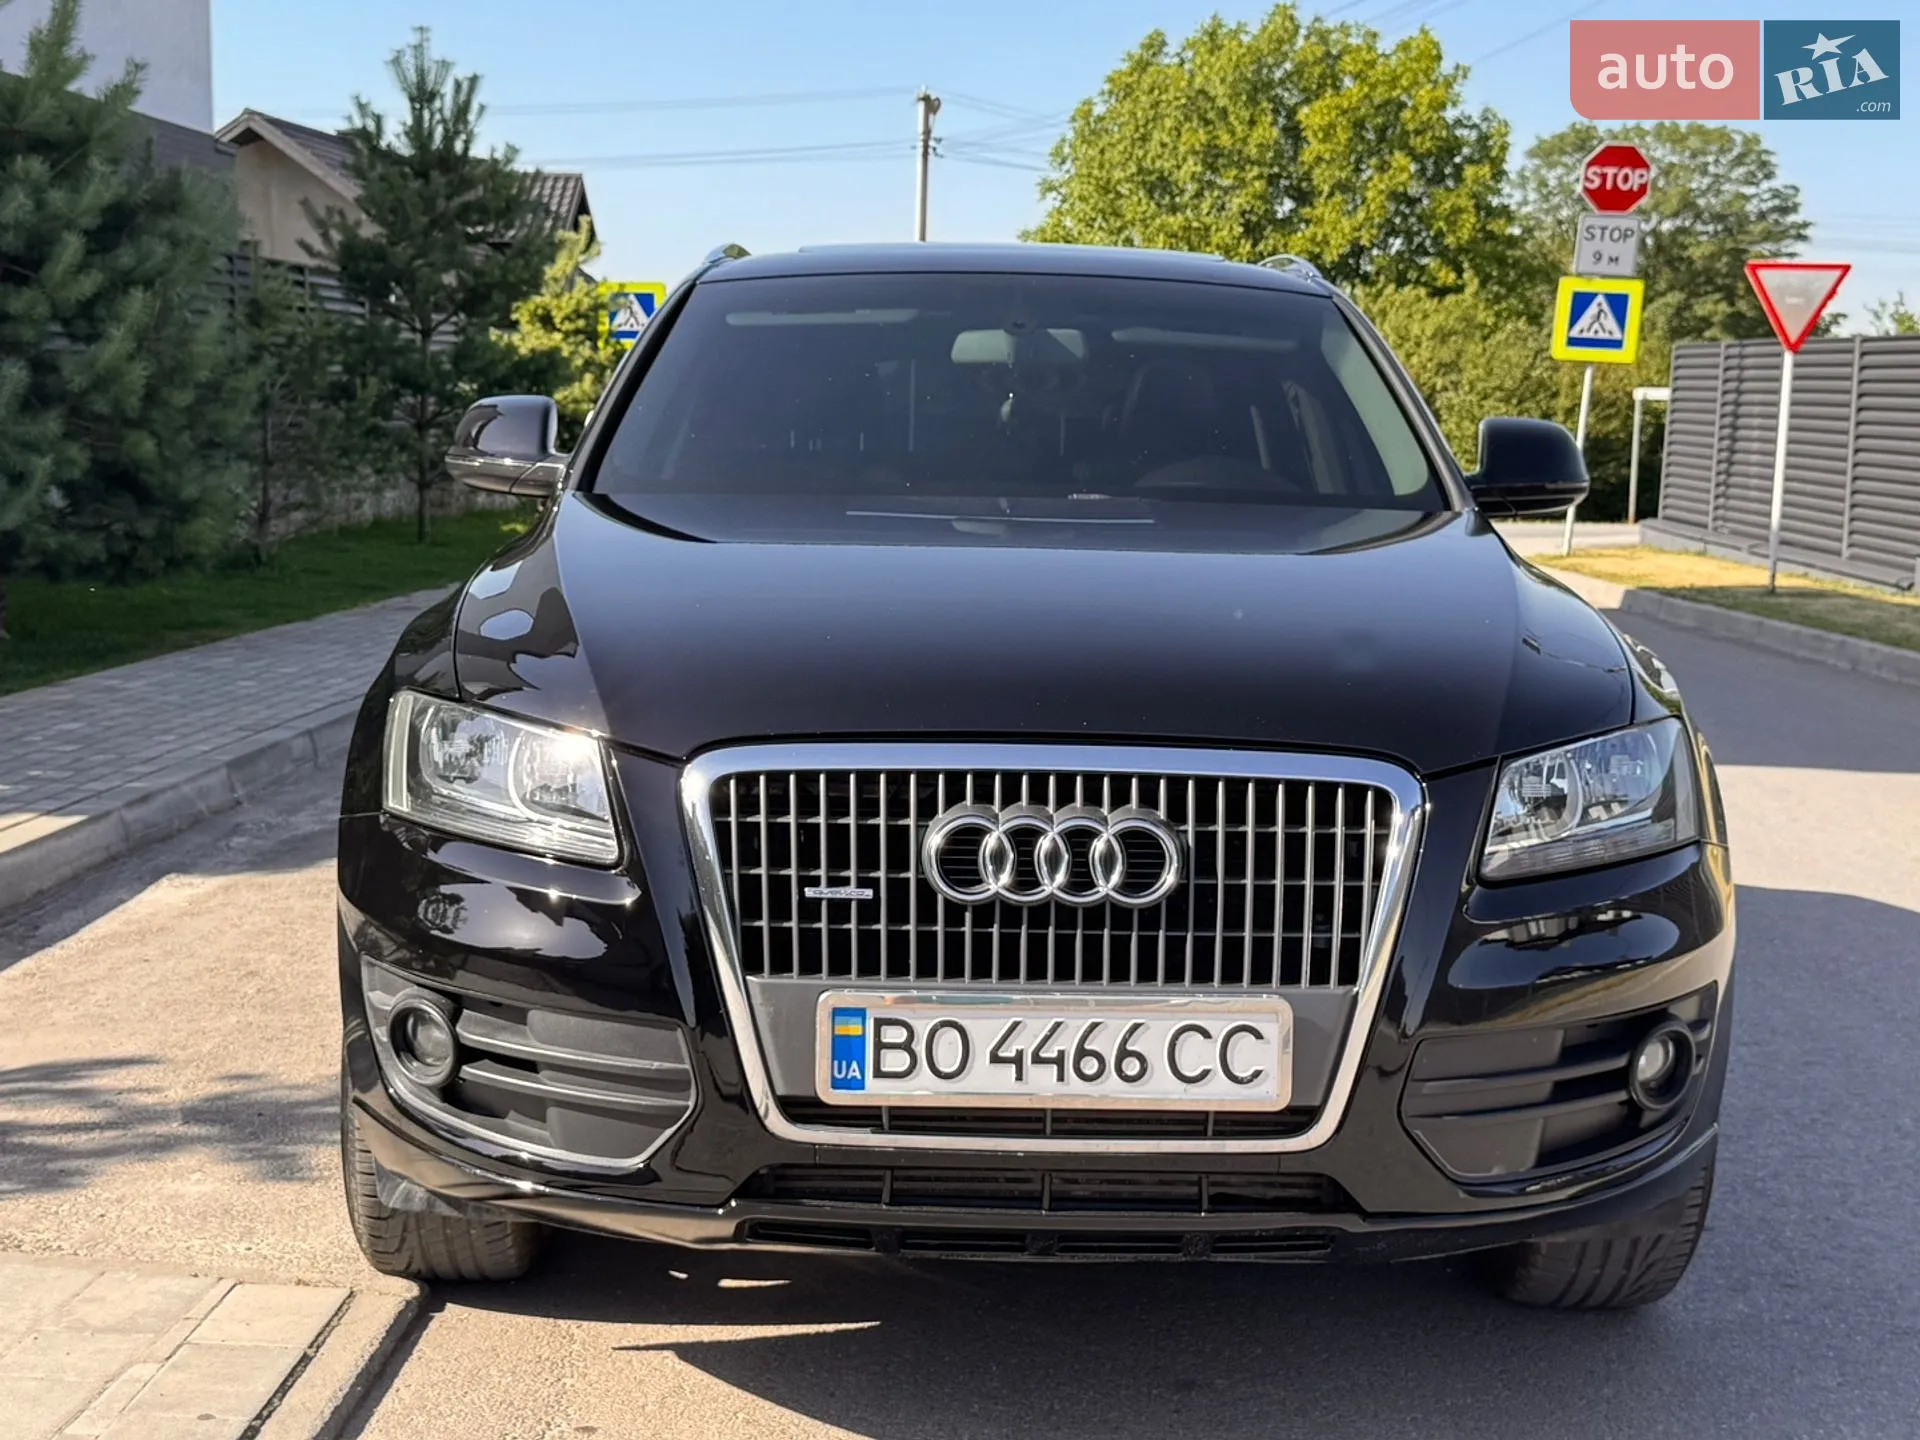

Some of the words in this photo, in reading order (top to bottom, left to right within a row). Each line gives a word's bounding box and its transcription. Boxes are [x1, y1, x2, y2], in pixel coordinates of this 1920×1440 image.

[1583, 165, 1649, 192] STOP
[1583, 224, 1635, 243] STOP
[1591, 249, 1603, 266] 9
[871, 1016, 970, 1080] BO
[989, 1019, 1149, 1084] 4466
[1166, 1022, 1265, 1085] CC
[833, 1061, 862, 1081] UA
